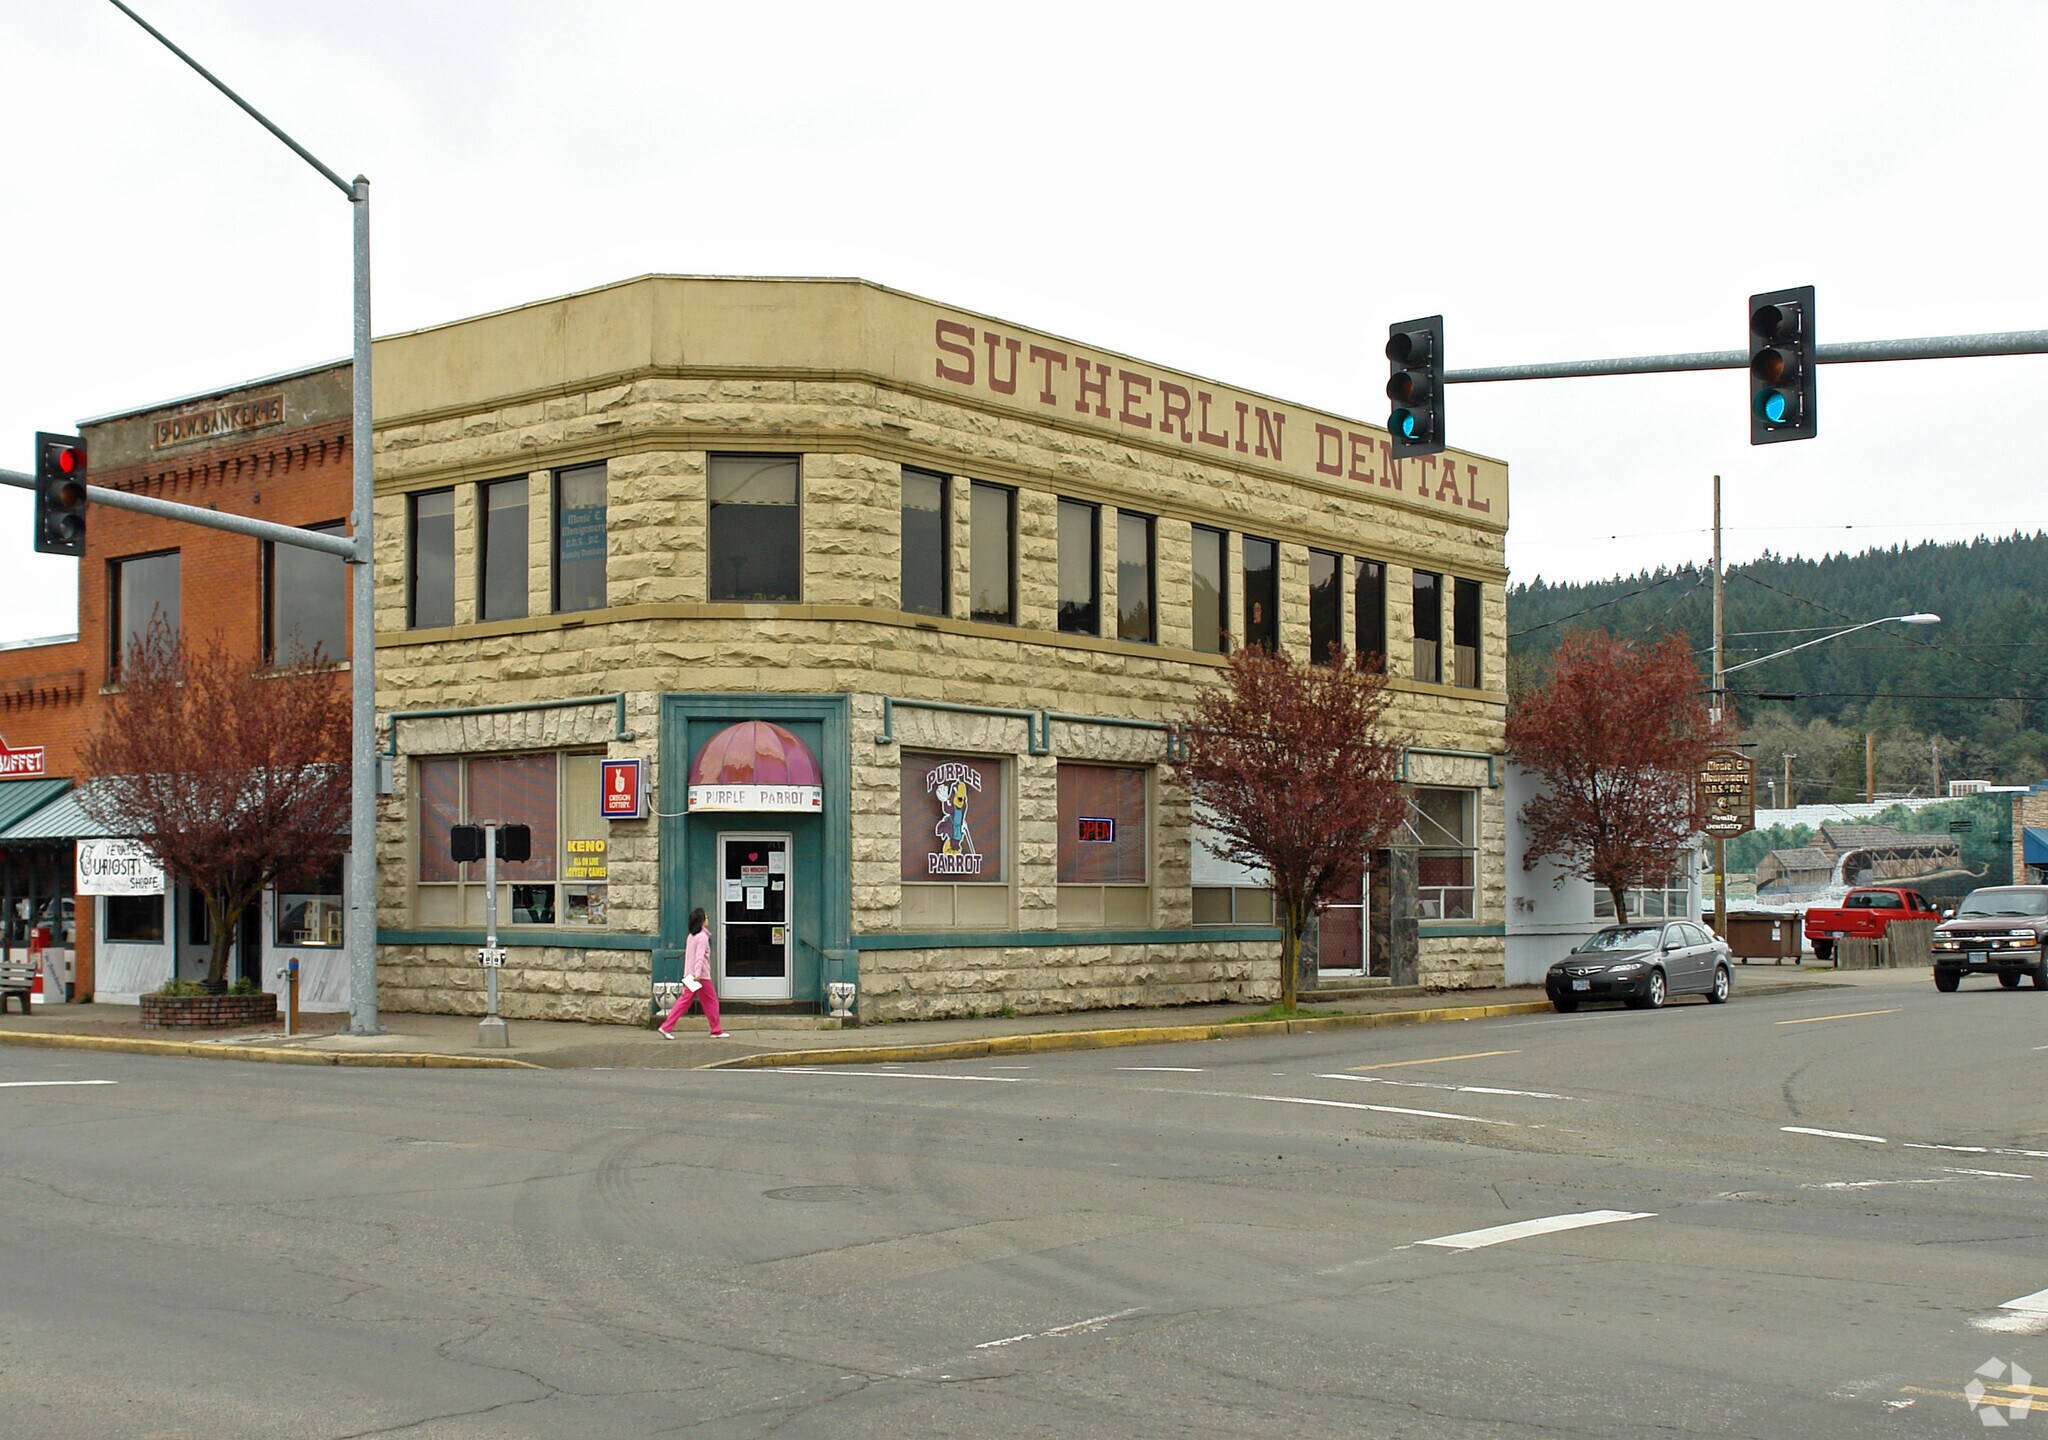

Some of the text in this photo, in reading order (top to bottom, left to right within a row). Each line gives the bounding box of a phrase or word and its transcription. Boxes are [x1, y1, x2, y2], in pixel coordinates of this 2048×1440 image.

[935, 319, 1490, 513] SUTHERLIN DENTAL
[926, 763, 983, 793] PURPLE
[1700, 772, 1749, 784] Montgomery
[608, 794, 631, 802] OREGON
[706, 790, 746, 804] PURPLE
[760, 791, 804, 805] PARROT
[1711, 814, 1738, 823] Family
[1079, 820, 1110, 840] OPEN
[1705, 822, 1743, 831] Dentistry
[567, 840, 605, 853] KENO
[928, 852, 983, 874] PARROT
[565, 866, 607, 878] LOTTERY GAMES
